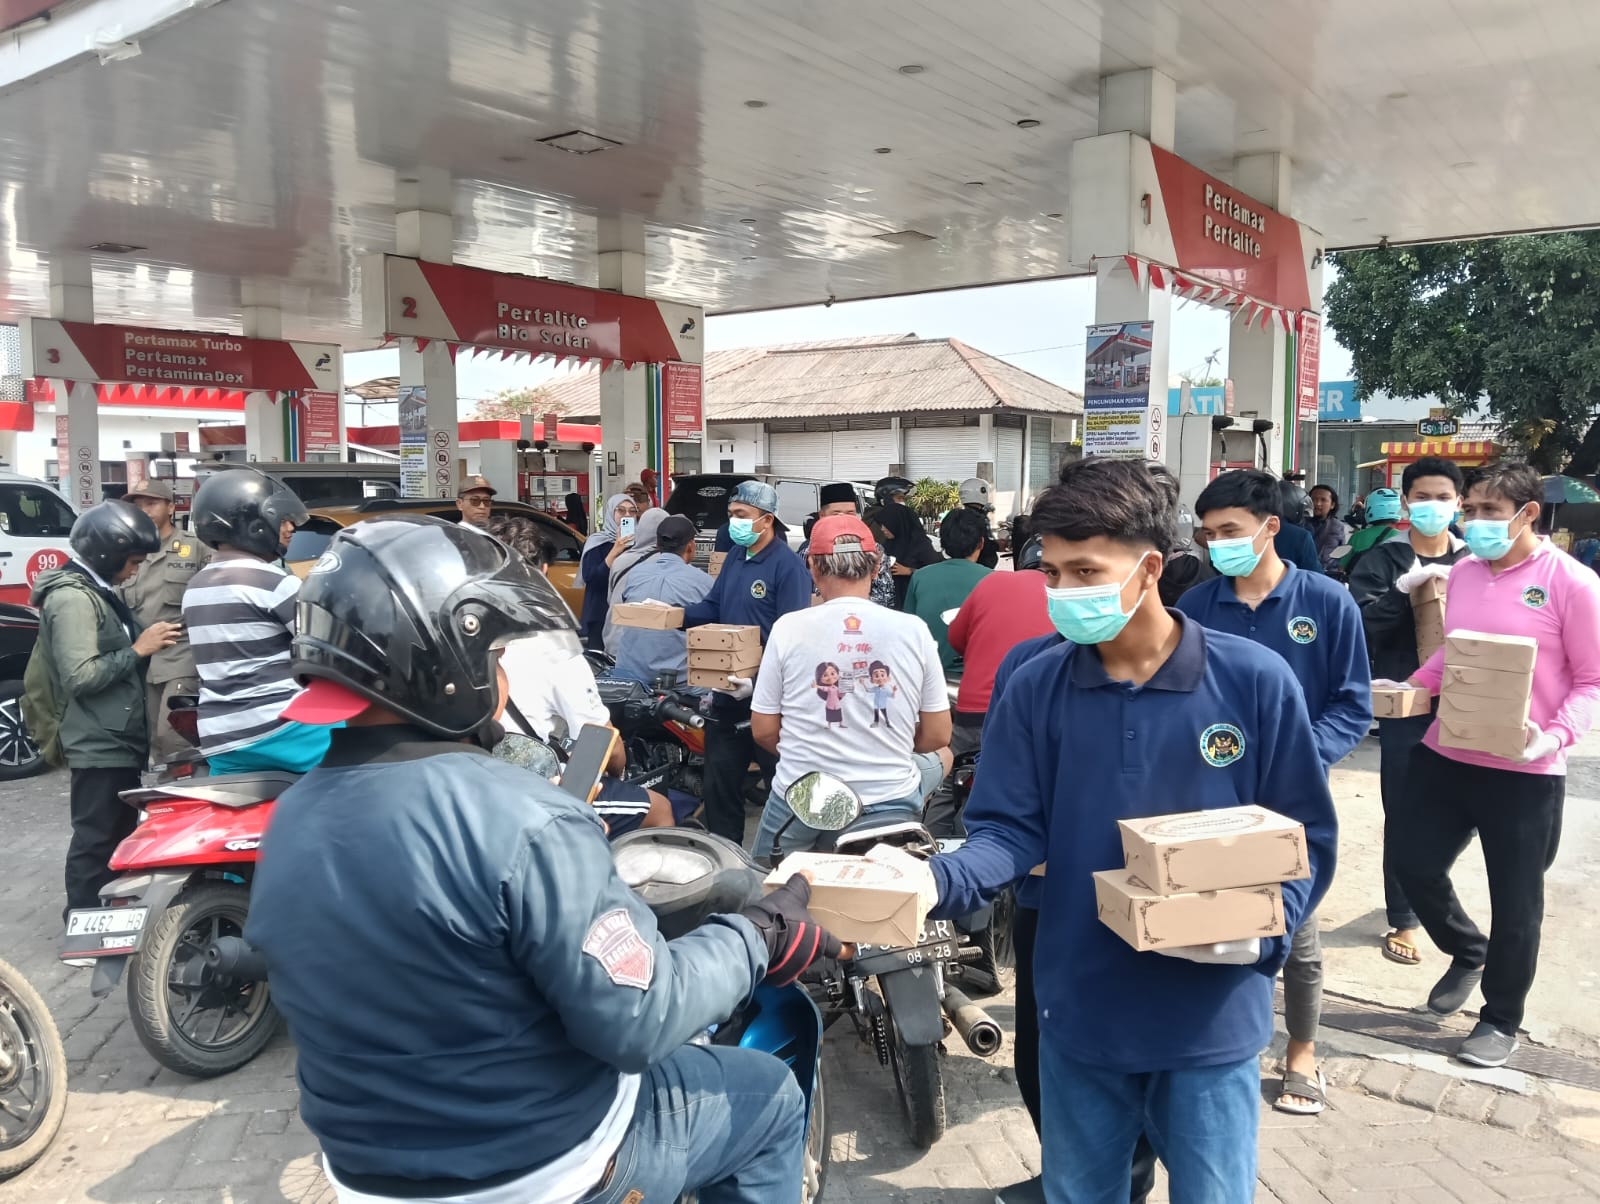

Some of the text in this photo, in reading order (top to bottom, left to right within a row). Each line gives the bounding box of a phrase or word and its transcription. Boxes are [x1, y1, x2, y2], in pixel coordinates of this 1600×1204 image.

[1204, 183, 1265, 234] Pertamax
[1204, 214, 1261, 259] Pertalite
[401, 296, 418, 319] 2
[497, 302, 588, 329] Pertalite
[124, 331, 243, 352] Pertamax Turbo
[497, 323, 591, 350] Bio Solar
[46, 348, 61, 364] 3
[125, 347, 208, 366] Pertamax
[1420, 421, 1457, 434] Es Teh
[37, 553, 58, 570] 99
[68, 916, 79, 934] P
[83, 914, 114, 933] 4462
